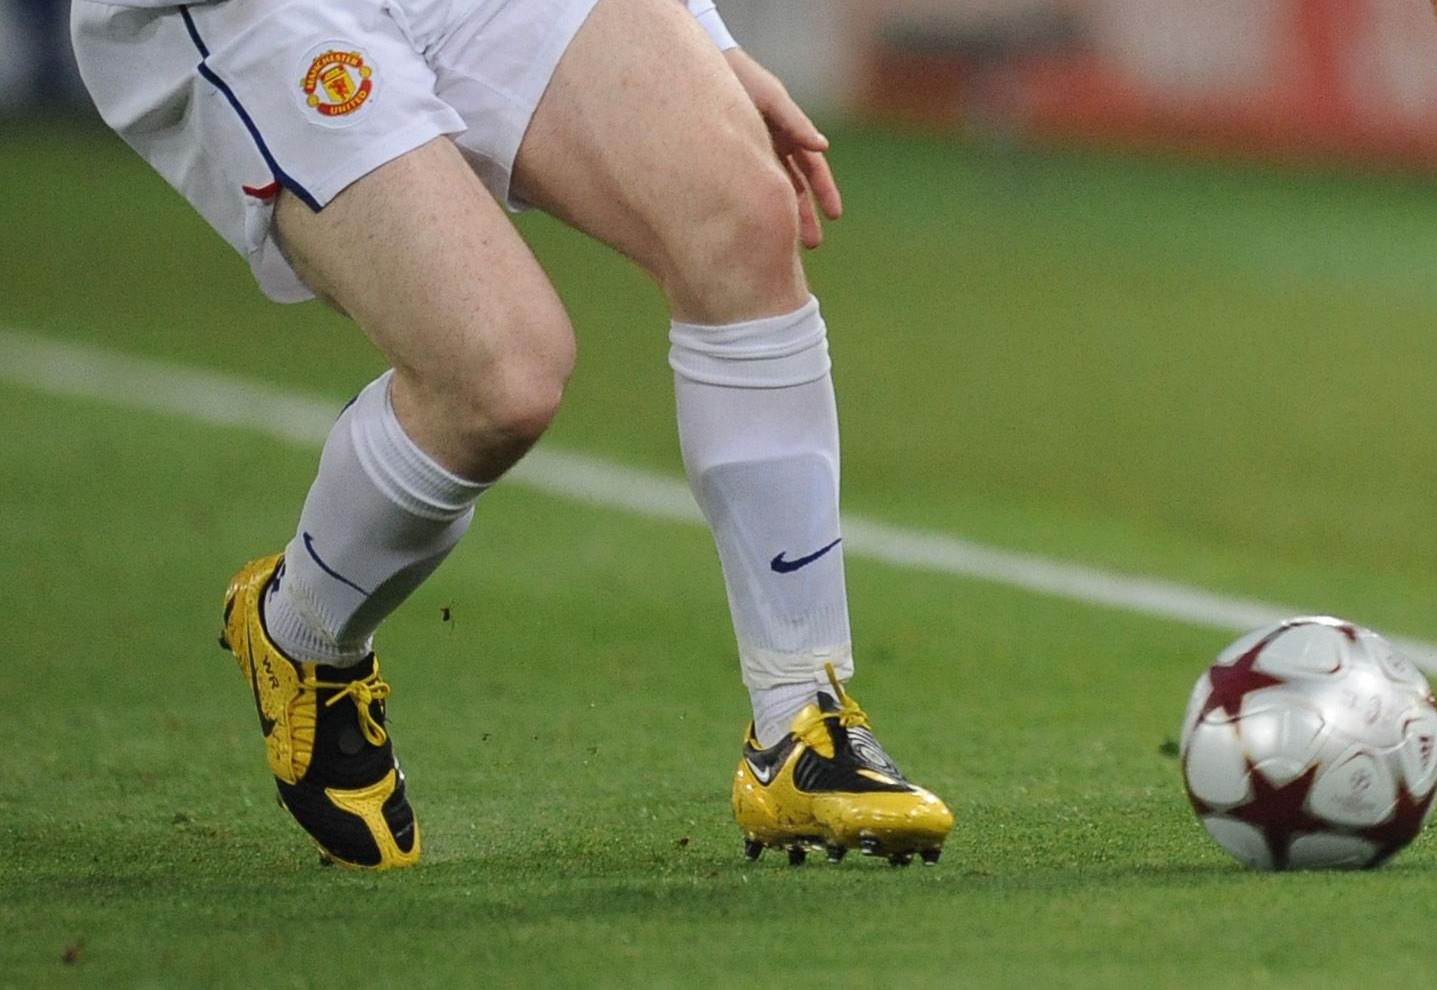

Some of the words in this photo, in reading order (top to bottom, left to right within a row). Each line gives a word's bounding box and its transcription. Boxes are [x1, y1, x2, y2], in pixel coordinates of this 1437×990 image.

[306, 54, 360, 90] MANCHESTER
[330, 90, 367, 115] UNITED
[262, 654, 280, 690] WR
